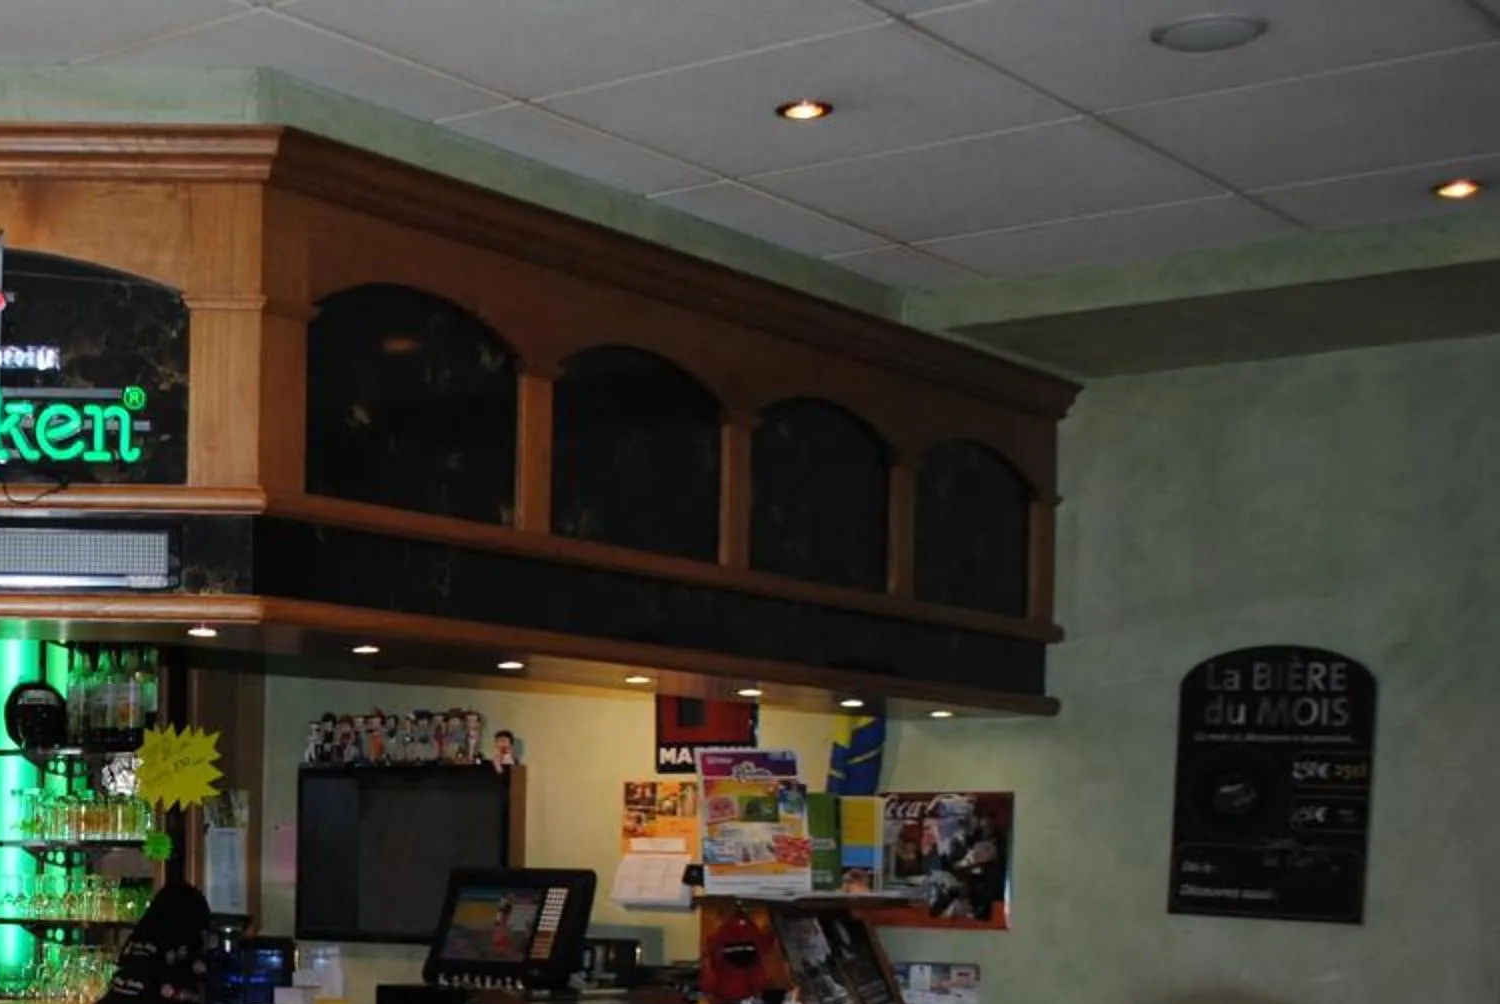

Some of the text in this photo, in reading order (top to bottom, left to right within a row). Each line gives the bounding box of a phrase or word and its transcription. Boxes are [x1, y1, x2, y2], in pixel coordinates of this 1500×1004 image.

[1205, 654, 1348, 692] La BIÈRE
[1204, 694, 1350, 727] du MOIS
